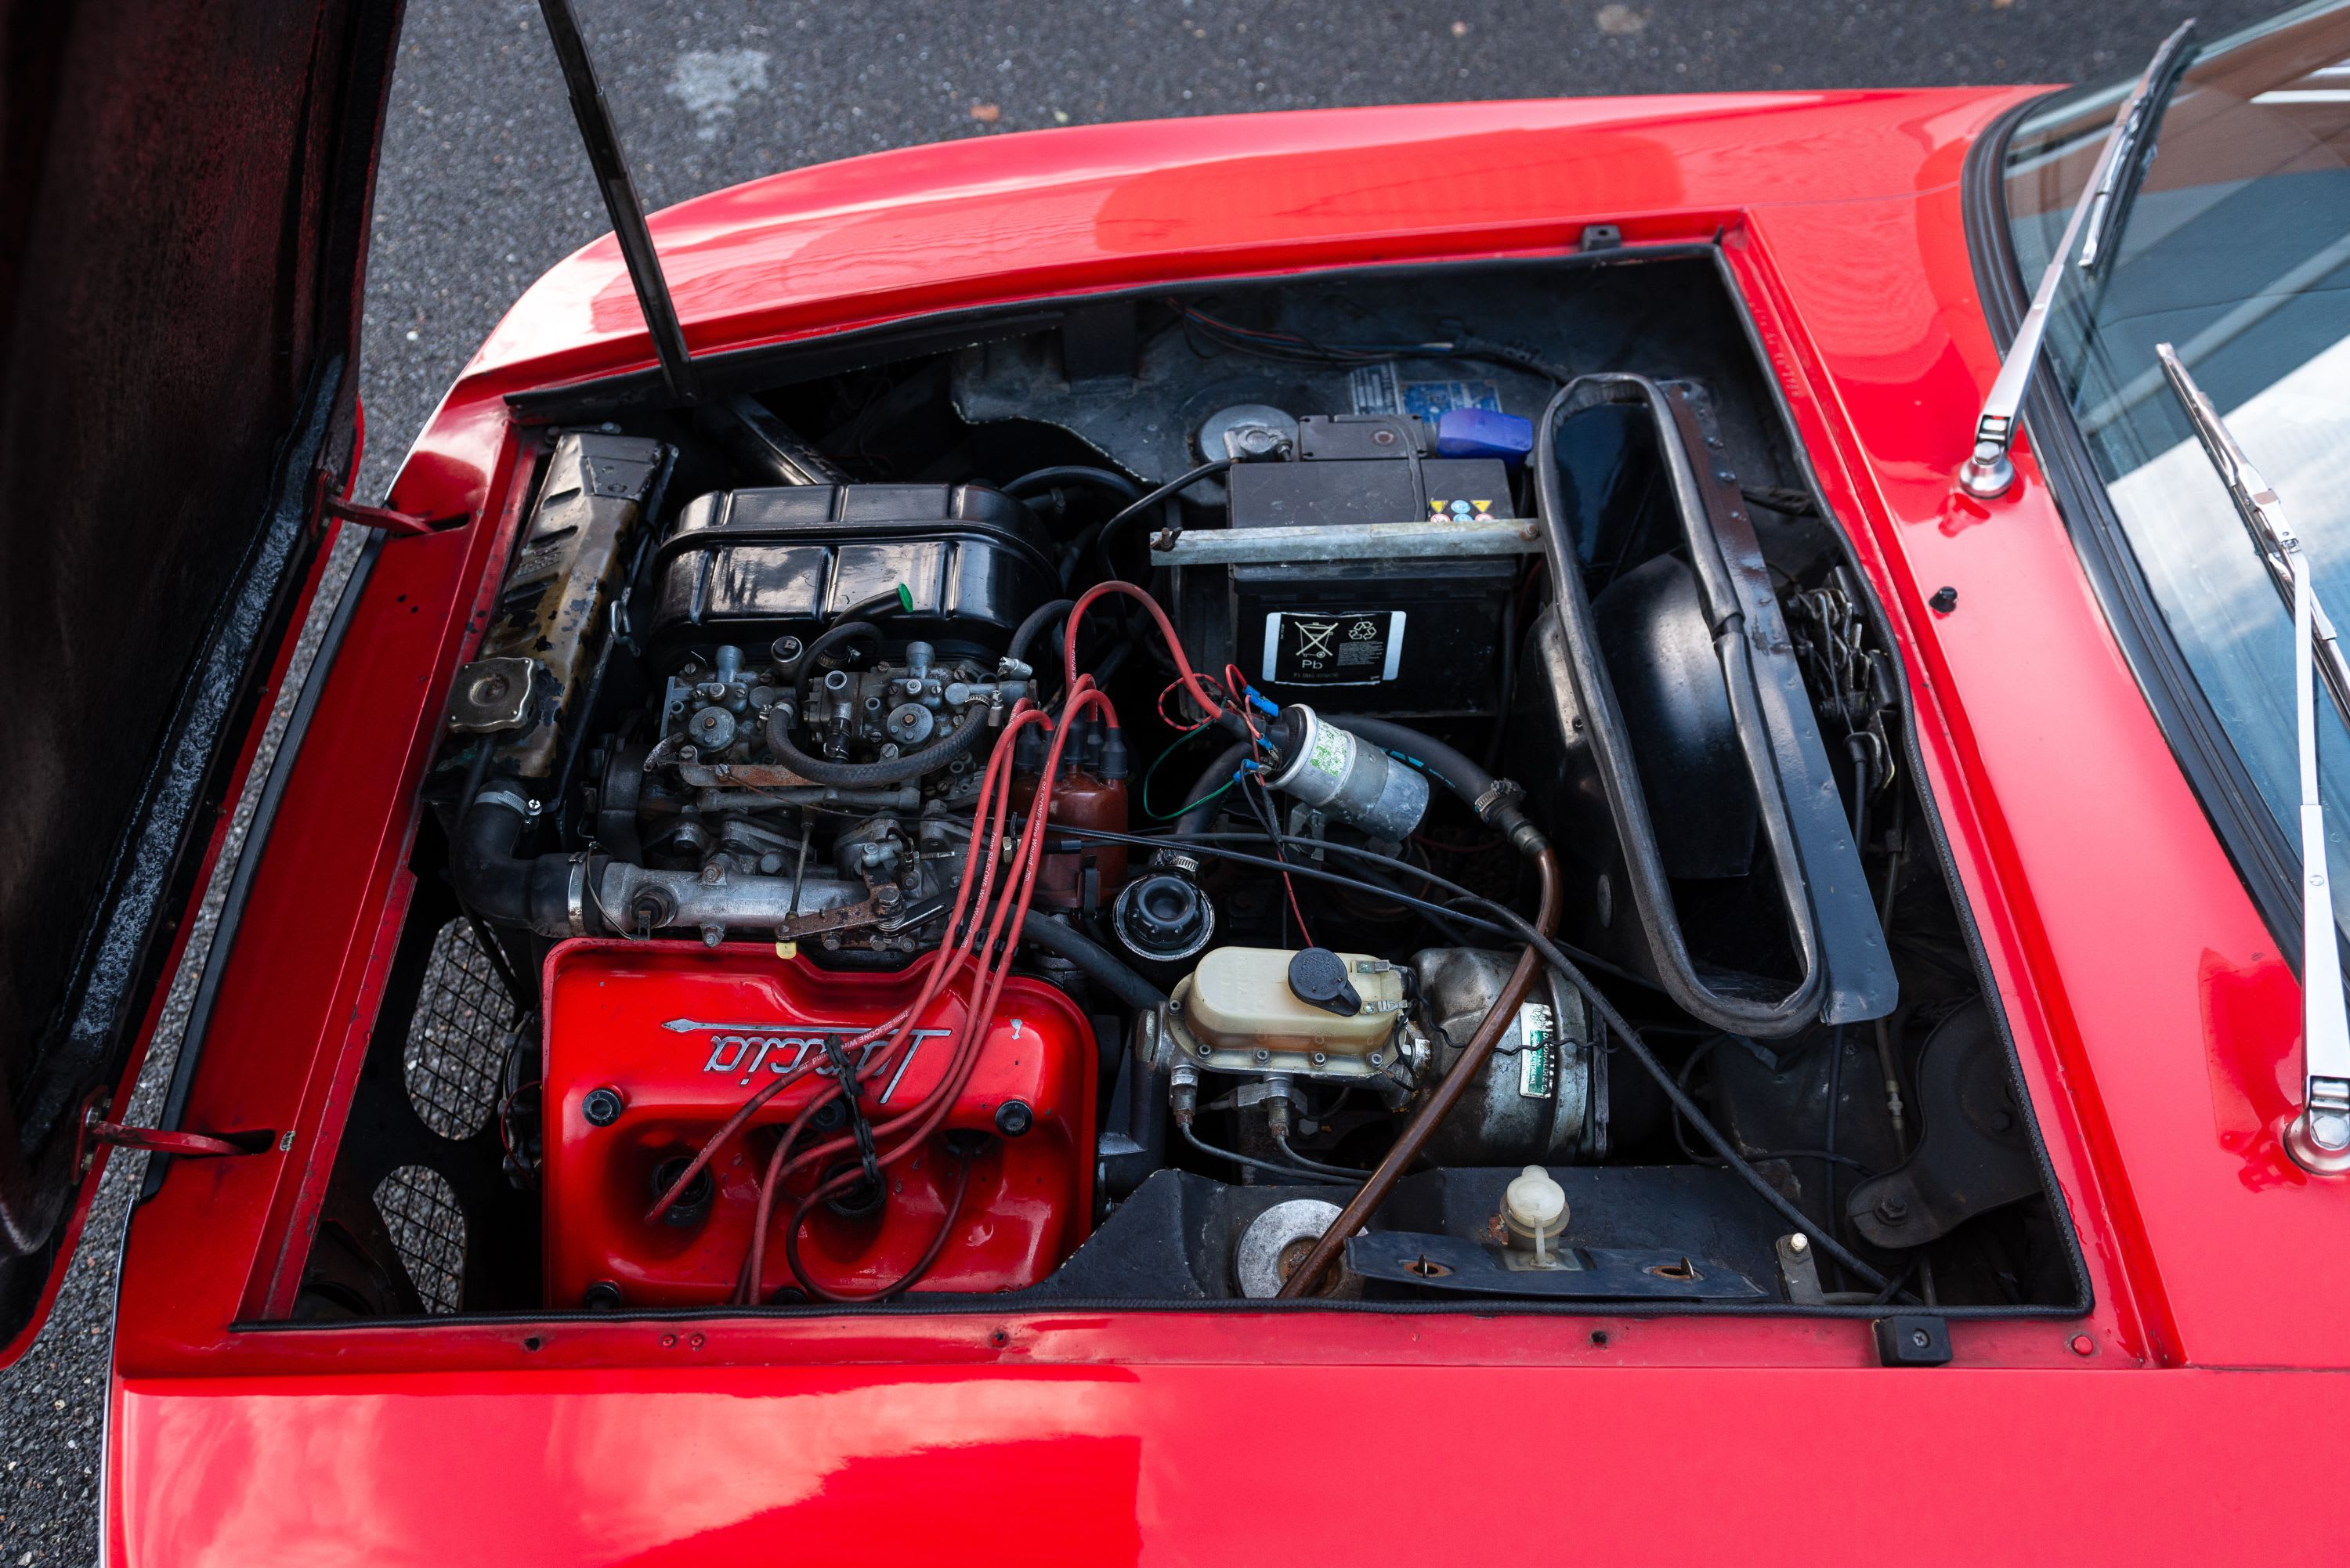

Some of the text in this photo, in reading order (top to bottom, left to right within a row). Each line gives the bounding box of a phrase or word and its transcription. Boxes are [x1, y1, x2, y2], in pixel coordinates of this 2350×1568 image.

[1302, 659, 1323, 669] Pb
[1036, 780, 1047, 818] SILICONE
[1027, 838, 1037, 865] Wound
[967, 831, 997, 933] 7mm SILICONE Wire Wound
[839, 1039, 856, 1050] Wire
[858, 1021, 893, 1043] SILICONE
[703, 1027, 951, 1104] Lancia
